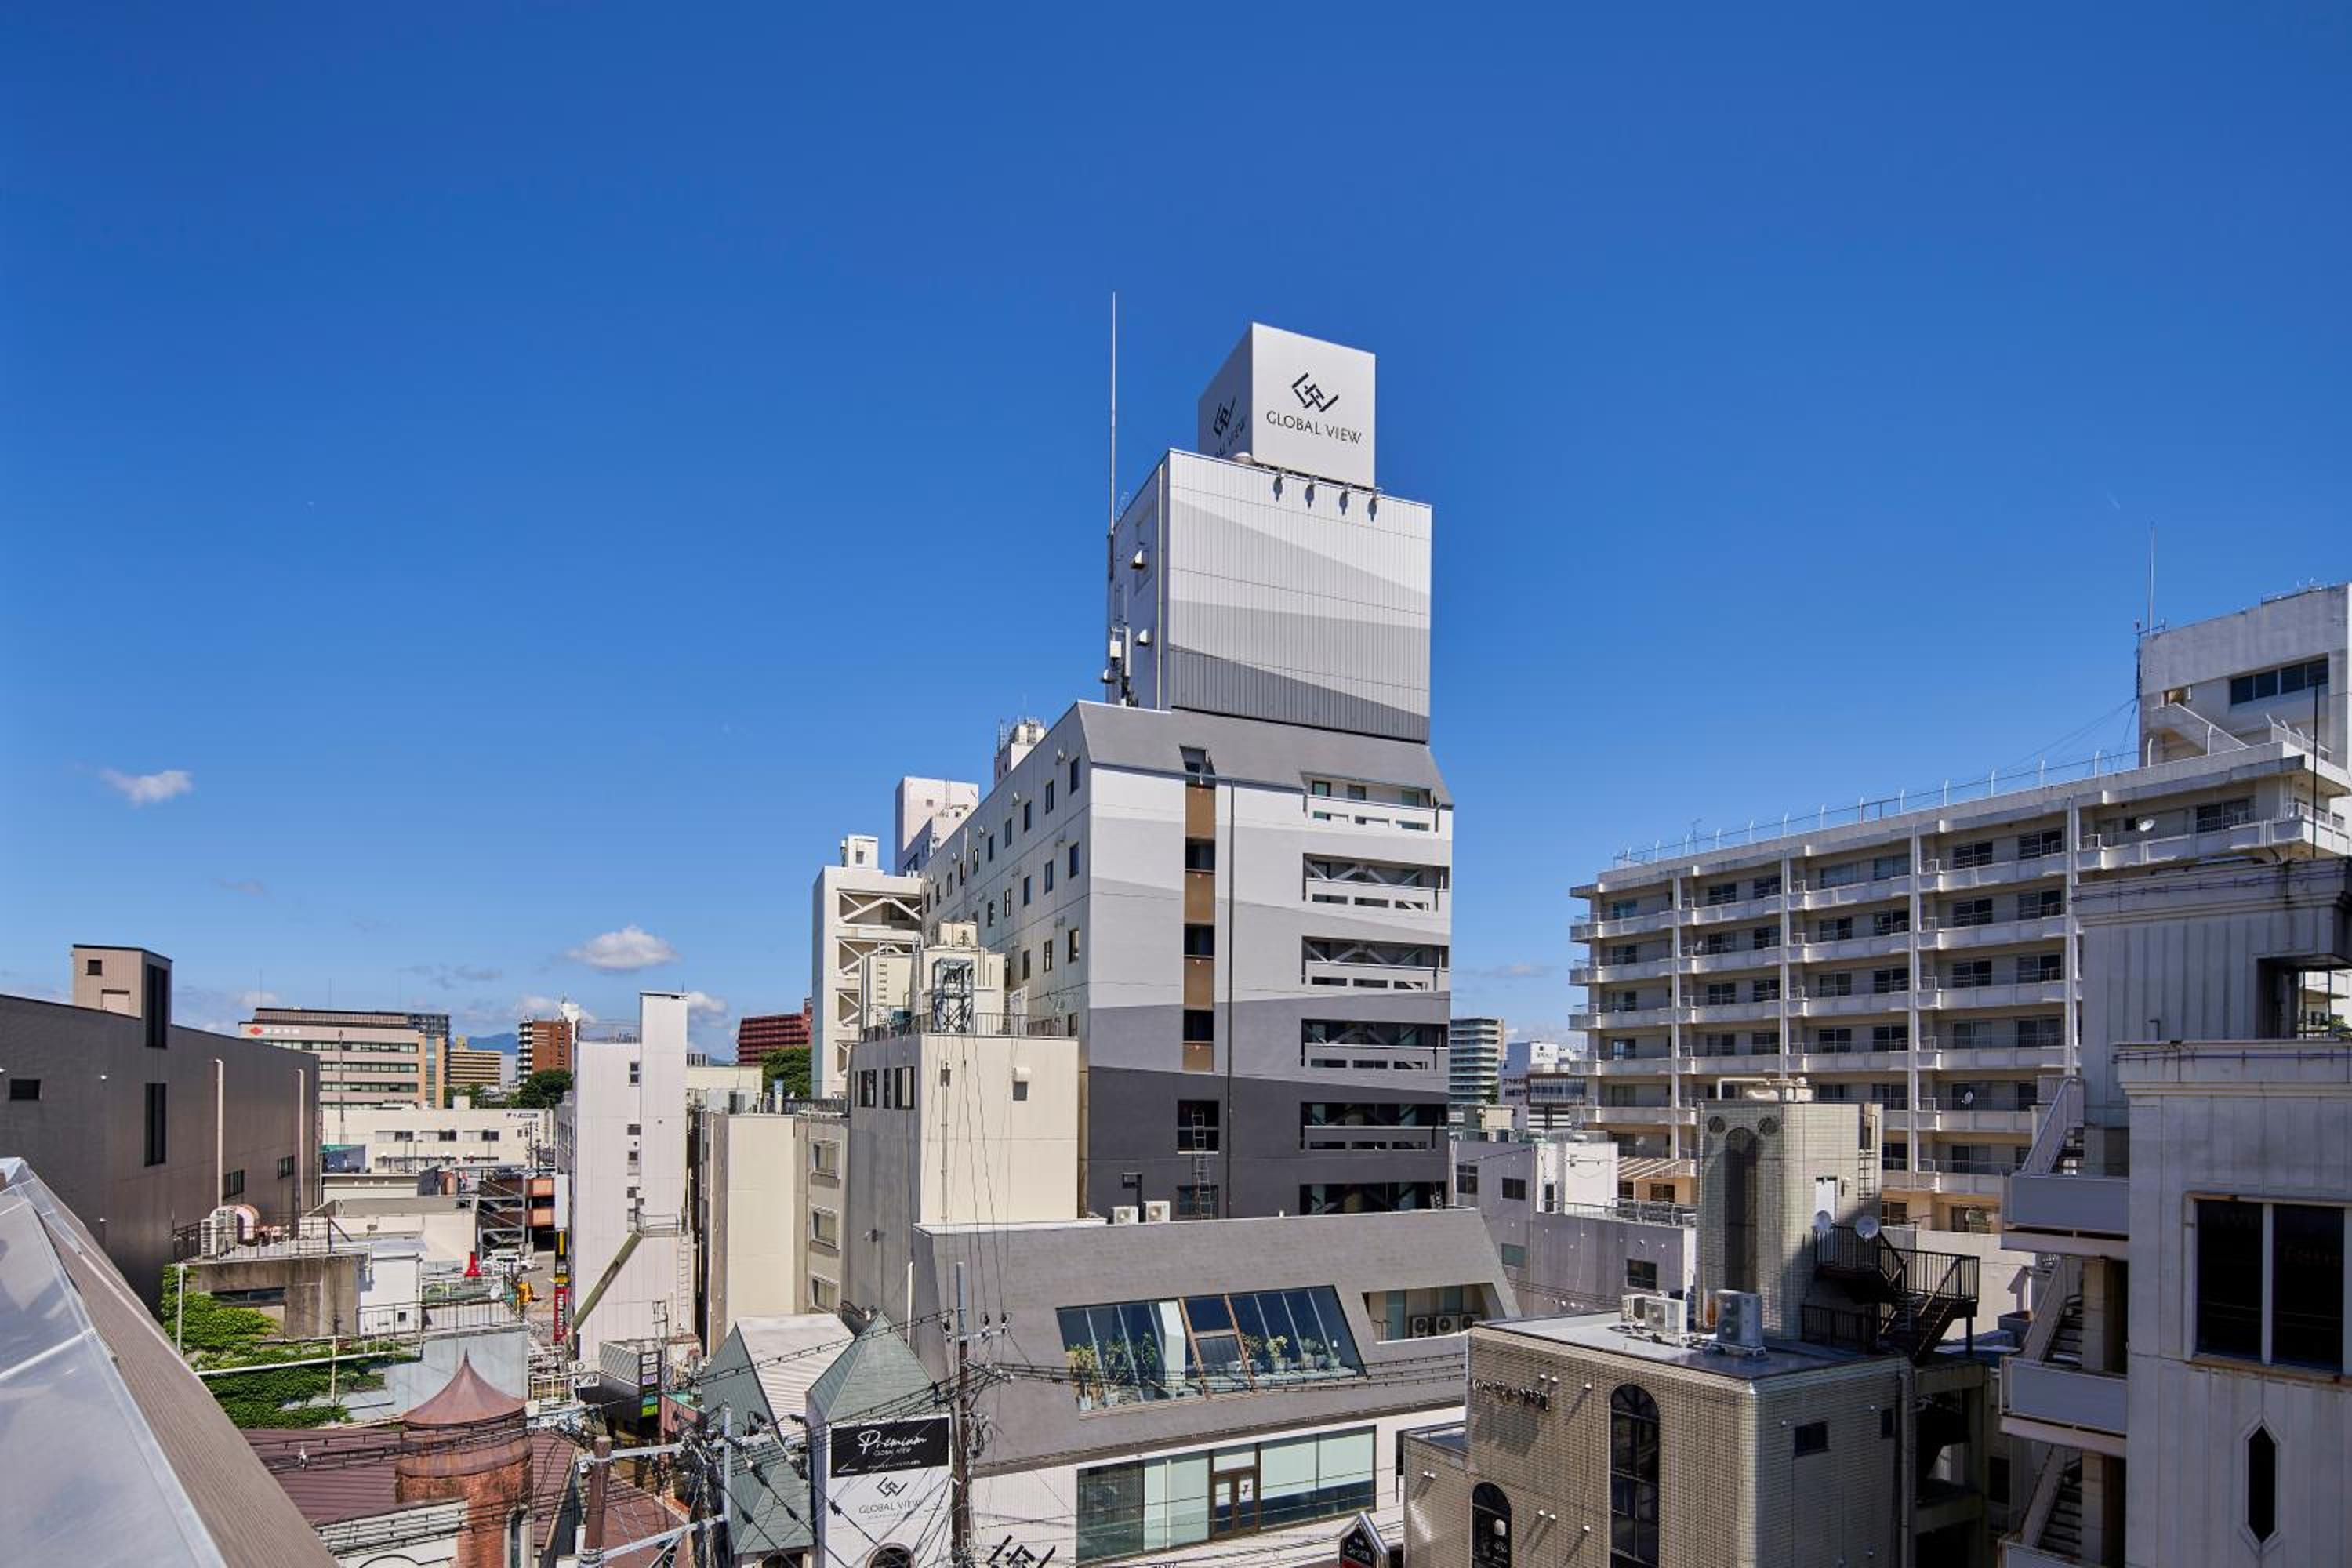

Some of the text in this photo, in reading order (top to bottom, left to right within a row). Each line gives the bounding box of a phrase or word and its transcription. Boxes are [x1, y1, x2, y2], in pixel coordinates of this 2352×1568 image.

[1266, 410, 1362, 444] GLOBAL VIEW
[858, 1502, 895, 1514] GLOBAL
